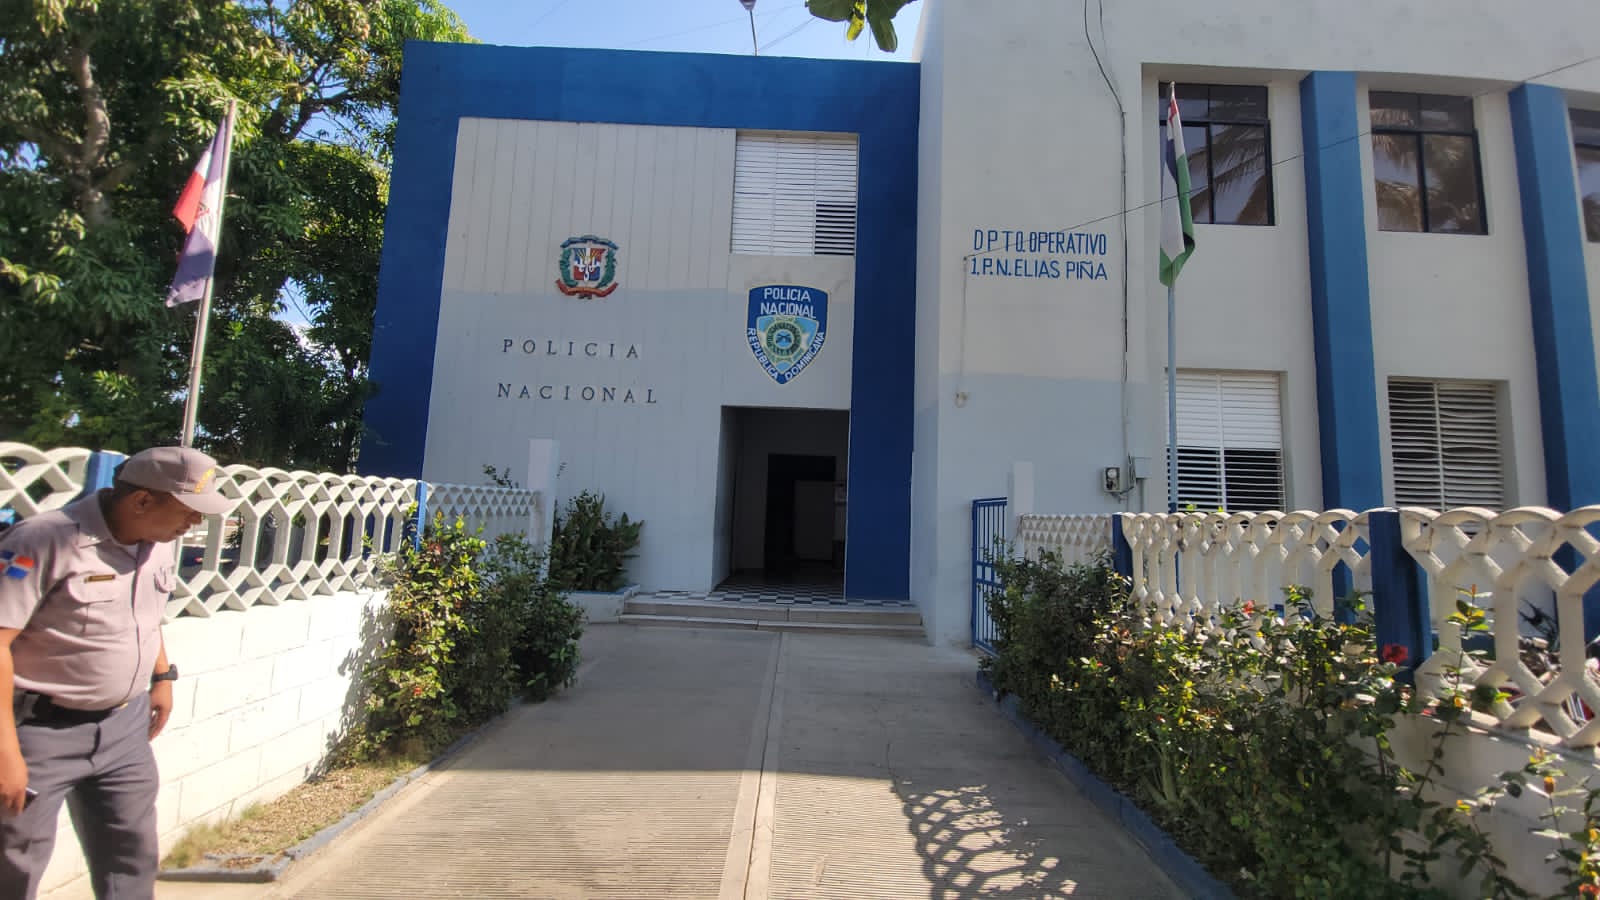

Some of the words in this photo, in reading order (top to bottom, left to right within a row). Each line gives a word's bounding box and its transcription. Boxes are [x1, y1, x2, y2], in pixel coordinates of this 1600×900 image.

[1029, 231, 1107, 256] OPERATIVO
[1014, 258, 1061, 279] ELIAS
[1065, 260, 1108, 281] PIÑA
[763, 287, 811, 302] POLICIA
[760, 302, 817, 319] NACIONAL
[502, 338, 639, 359] POLICIA
[747, 327, 779, 380] REPUBLICA
[784, 331, 825, 381] DOMINICANA
[497, 382, 657, 404] NACIONAL
